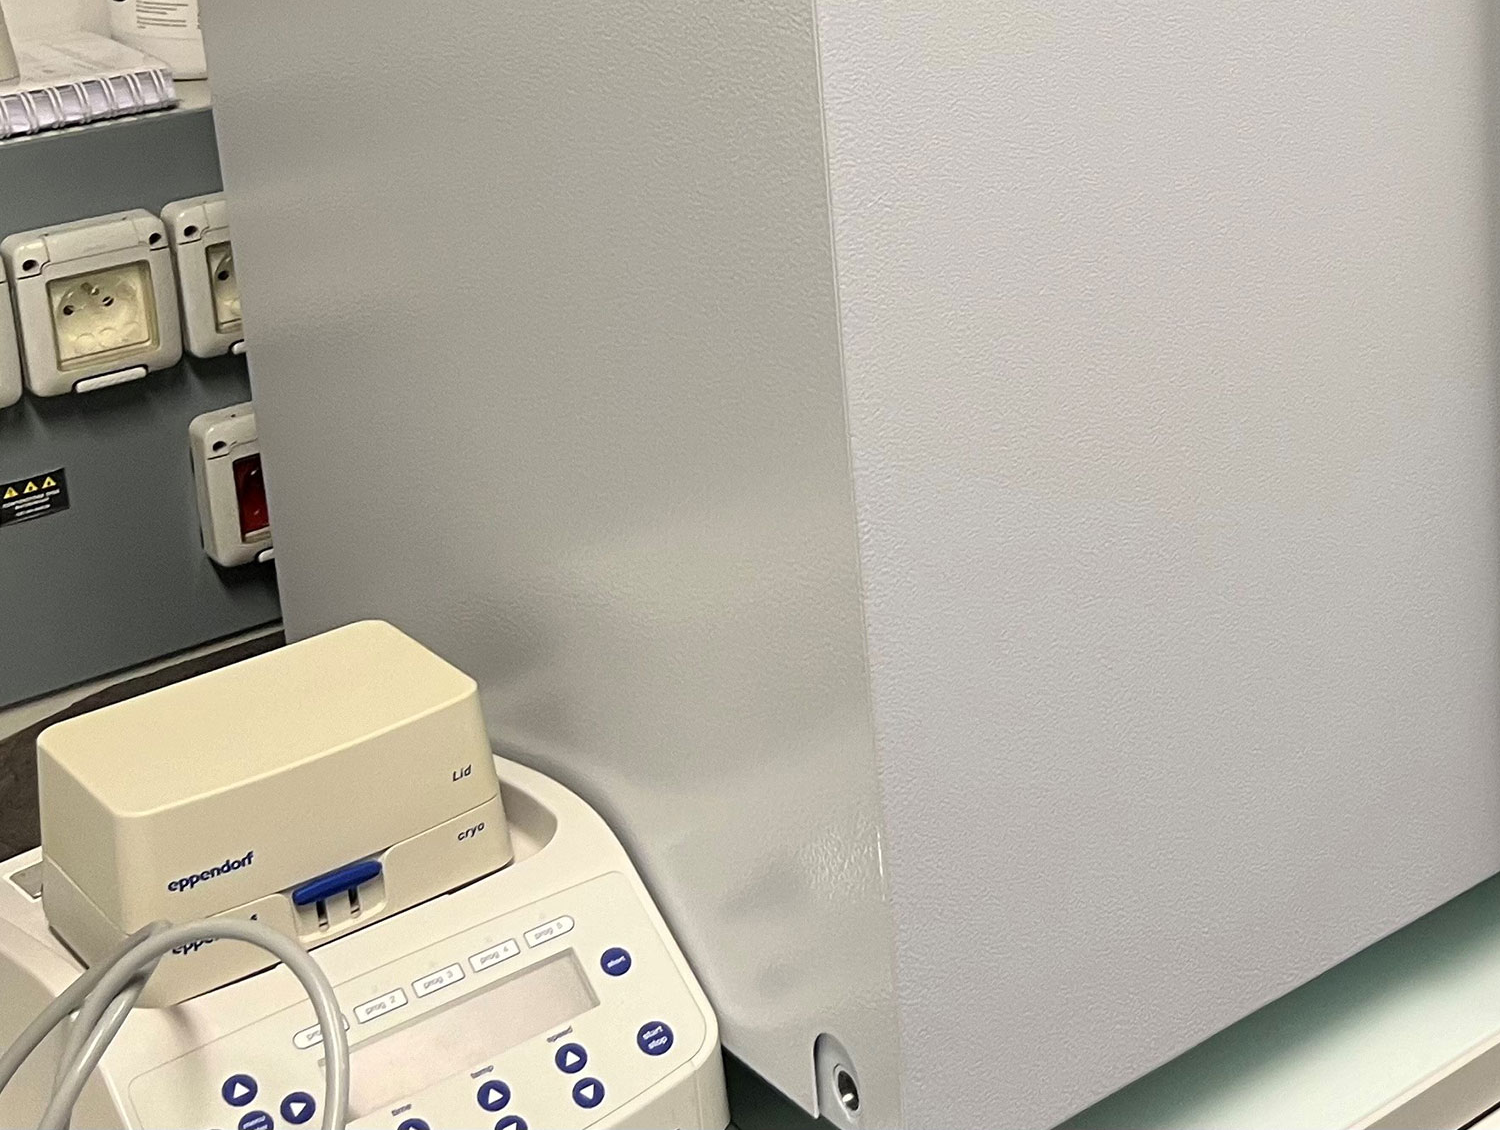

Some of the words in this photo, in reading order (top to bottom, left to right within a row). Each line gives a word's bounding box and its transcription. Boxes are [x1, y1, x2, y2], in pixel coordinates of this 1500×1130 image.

[452, 764, 472, 782] Lid
[458, 822, 485, 841] cryo
[168, 850, 254, 892] eppendorf
[648, 1036, 668, 1050] stop
